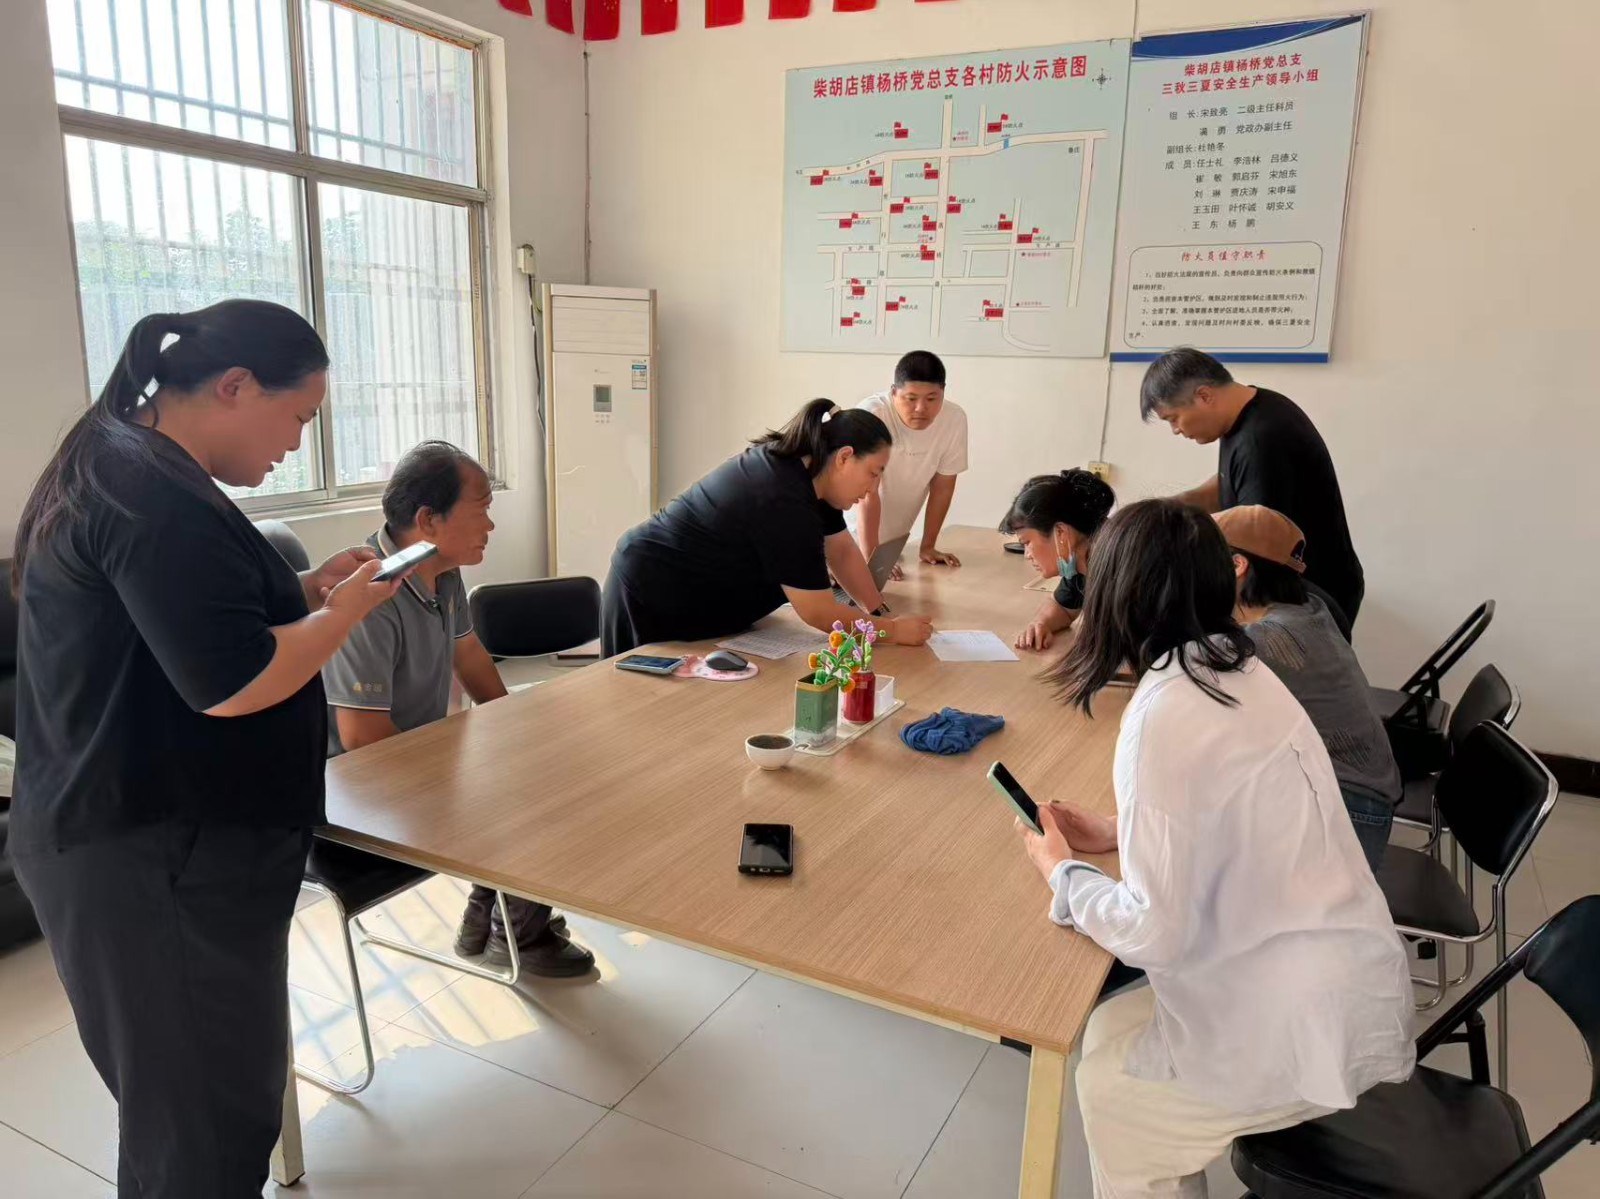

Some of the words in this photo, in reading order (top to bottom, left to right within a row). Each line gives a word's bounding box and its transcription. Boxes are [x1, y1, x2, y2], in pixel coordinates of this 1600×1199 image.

[1184, 53, 1302, 76] 柴胡店镇杨桥党总支
[813, 55, 1087, 98] 柴胡店镇杨桥党总支各村防火示意图
[1162, 69, 1319, 95] 三秋三夏安全生产领导小组
[1237, 101, 1294, 115] 二级主任科员
[1236, 121, 1293, 134] 党政办副主任
